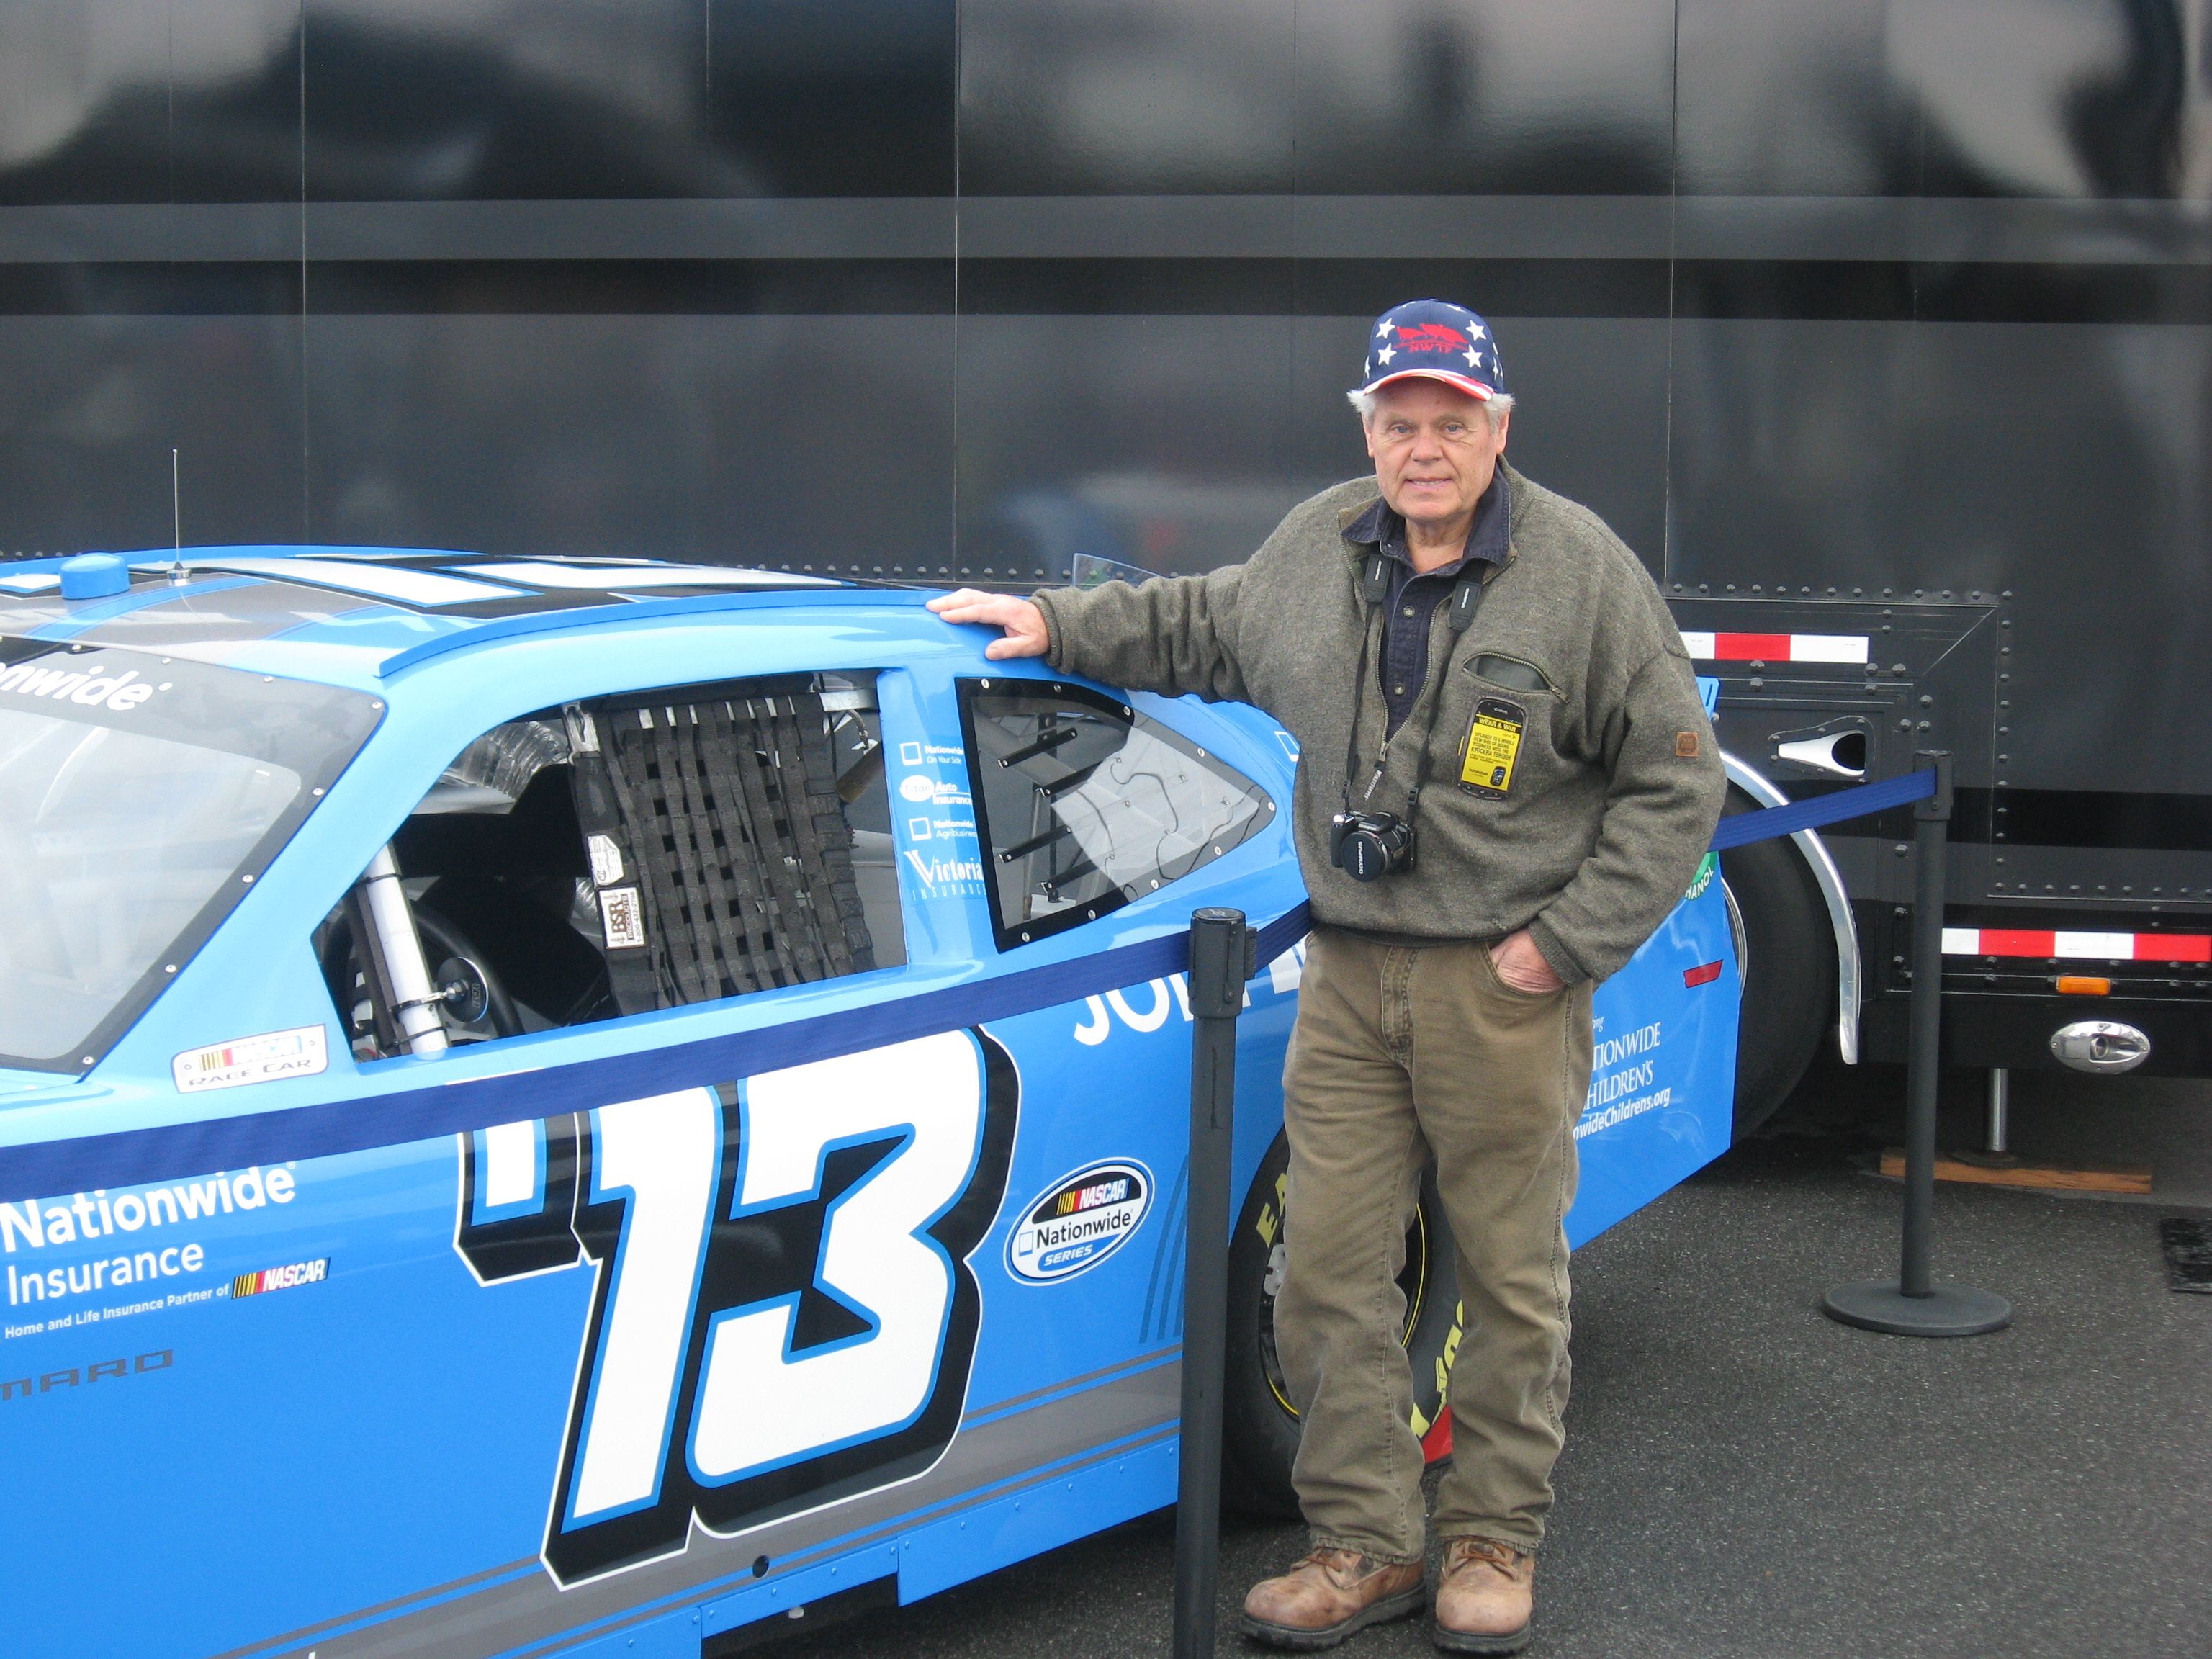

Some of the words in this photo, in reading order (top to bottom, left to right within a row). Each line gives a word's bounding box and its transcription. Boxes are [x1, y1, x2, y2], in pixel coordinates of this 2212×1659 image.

[0, 662, 153, 711] nwide
[1479, 717, 1496, 727] WEAR
[935, 781, 957, 791] Auto
[903, 850, 984, 887] Victoria
[608, 900, 626, 934] BSR
[189, 1069, 251, 1086] RACE
[263, 1059, 312, 1073] CAR
[1583, 1059, 1653, 1110] HILDREN'S
[0, 1164, 296, 1253] Nationwide
[1079, 1178, 1127, 1210] NASCAR
[1037, 1209, 1131, 1249] Nationwide
[7, 1242, 204, 1306] Insurance
[1044, 1244, 1094, 1267] SERIES
[5, 1322, 44, 1339] Home
[48, 1313, 72, 1331] and
[76, 1309, 100, 1326] Life
[103, 1298, 164, 1320] Insurance
[167, 1288, 213, 1307] Partner
[216, 1283, 230, 1297] of
[262, 1258, 327, 1292] NASCAR
